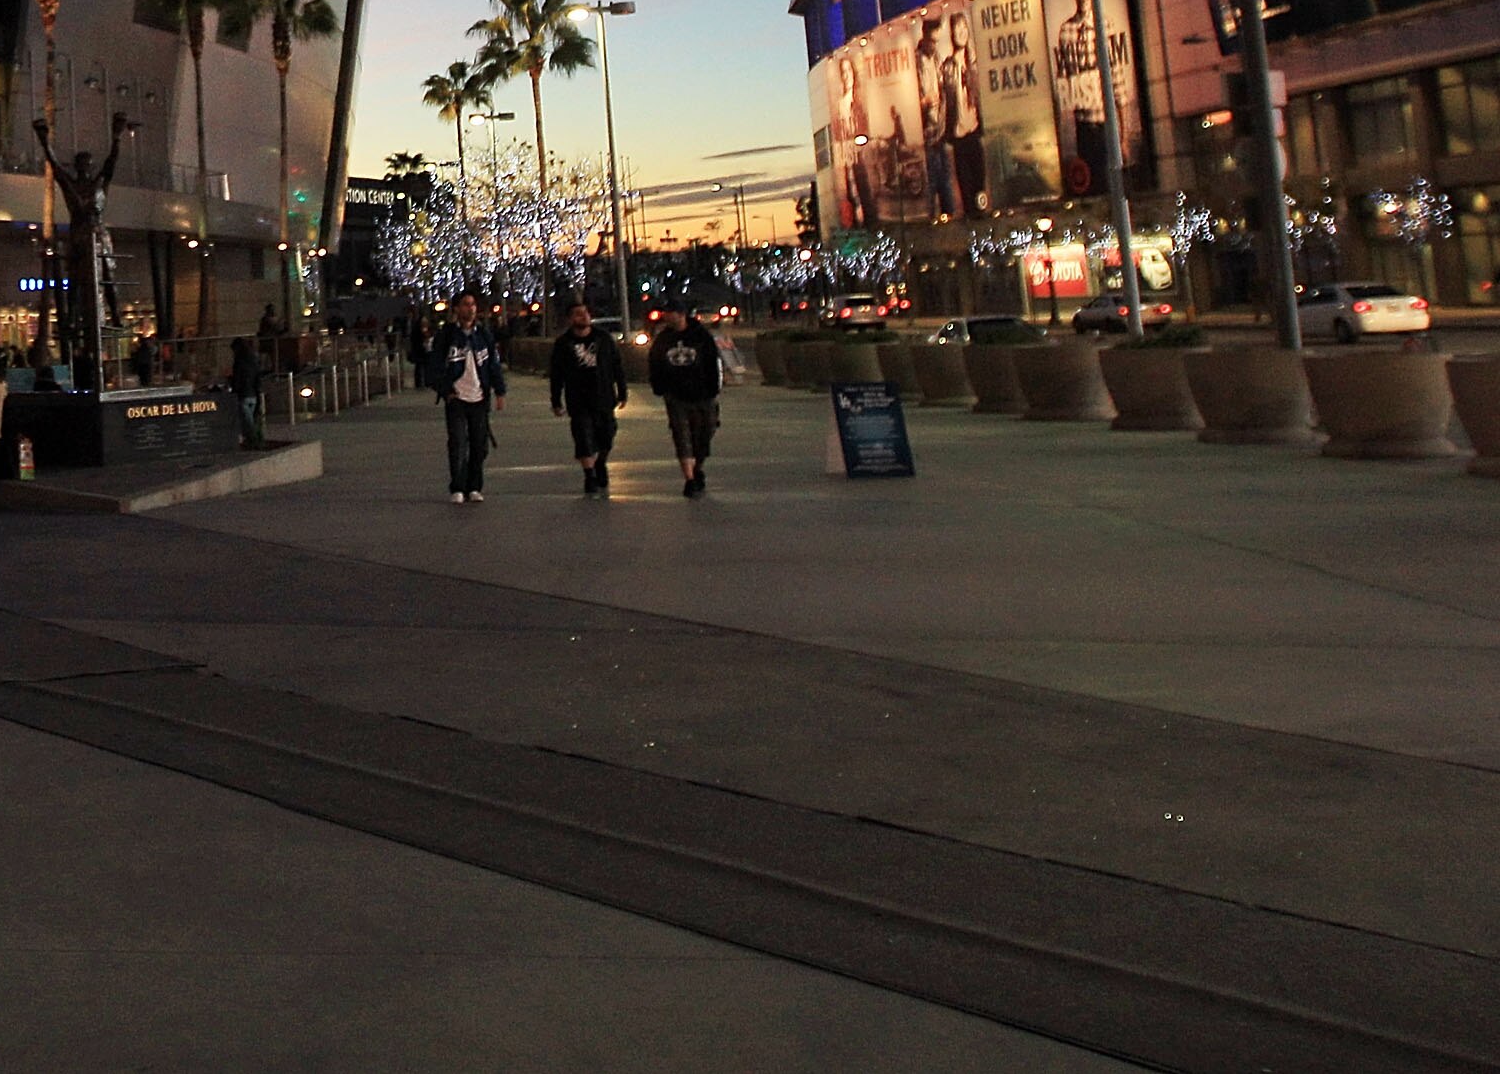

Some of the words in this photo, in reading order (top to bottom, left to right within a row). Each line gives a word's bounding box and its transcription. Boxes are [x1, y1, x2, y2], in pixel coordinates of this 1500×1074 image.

[988, 31, 1029, 60] LOOK
[864, 46, 911, 78] TRUTH
[988, 62, 1038, 93] BACK
[126, 406, 160, 419] OSCAR
[162, 404, 176, 416] DE
[178, 403, 190, 414] LA
[192, 401, 217, 413] HOYA
